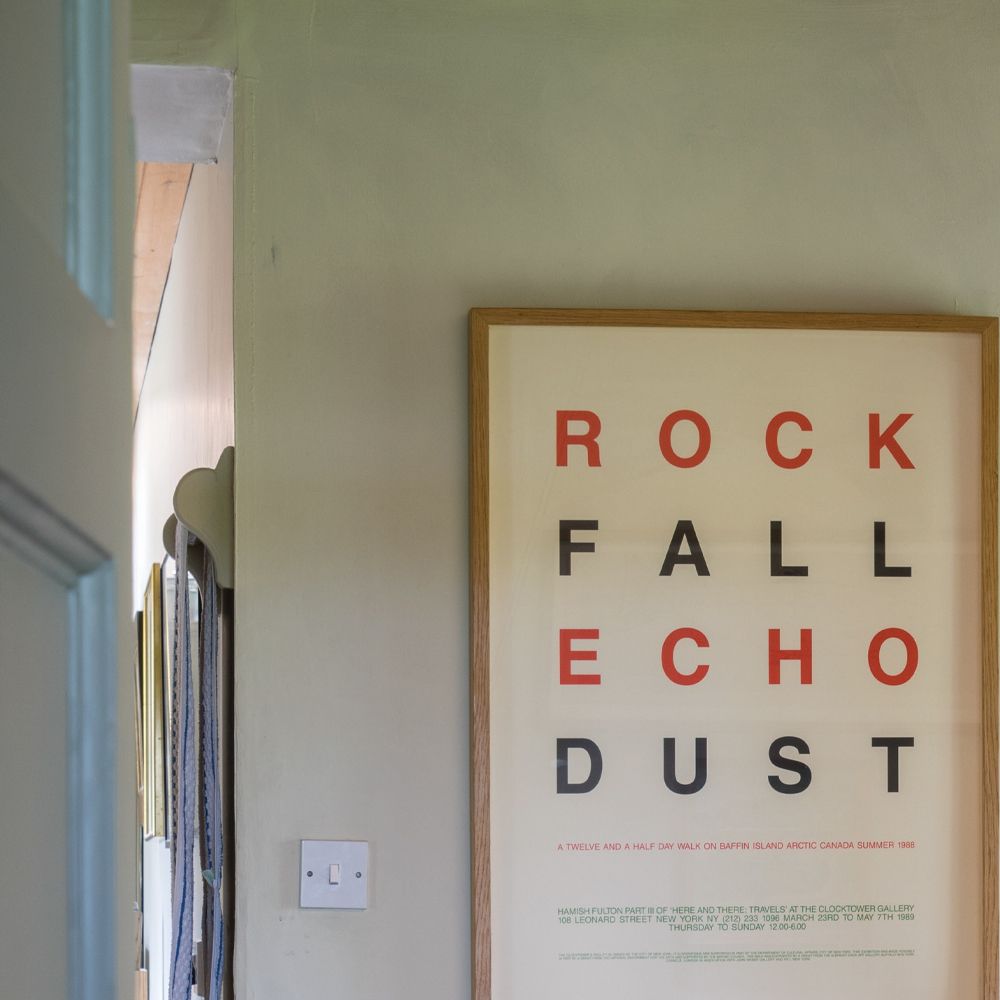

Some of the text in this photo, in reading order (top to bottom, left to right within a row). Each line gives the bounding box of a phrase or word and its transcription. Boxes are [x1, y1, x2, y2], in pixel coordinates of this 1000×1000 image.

[555, 409, 916, 469] ROCK
[558, 520, 912, 577] FALL
[559, 627, 919, 686] ECHO
[556, 736, 915, 795] DUST
[558, 843, 563, 851] A
[559, 916, 571, 924] 108
[656, 915, 676, 923] NEW
[722, 915, 740, 923] (212)
[801, 905, 817, 913] THE
[718, 923, 728, 931] TO
